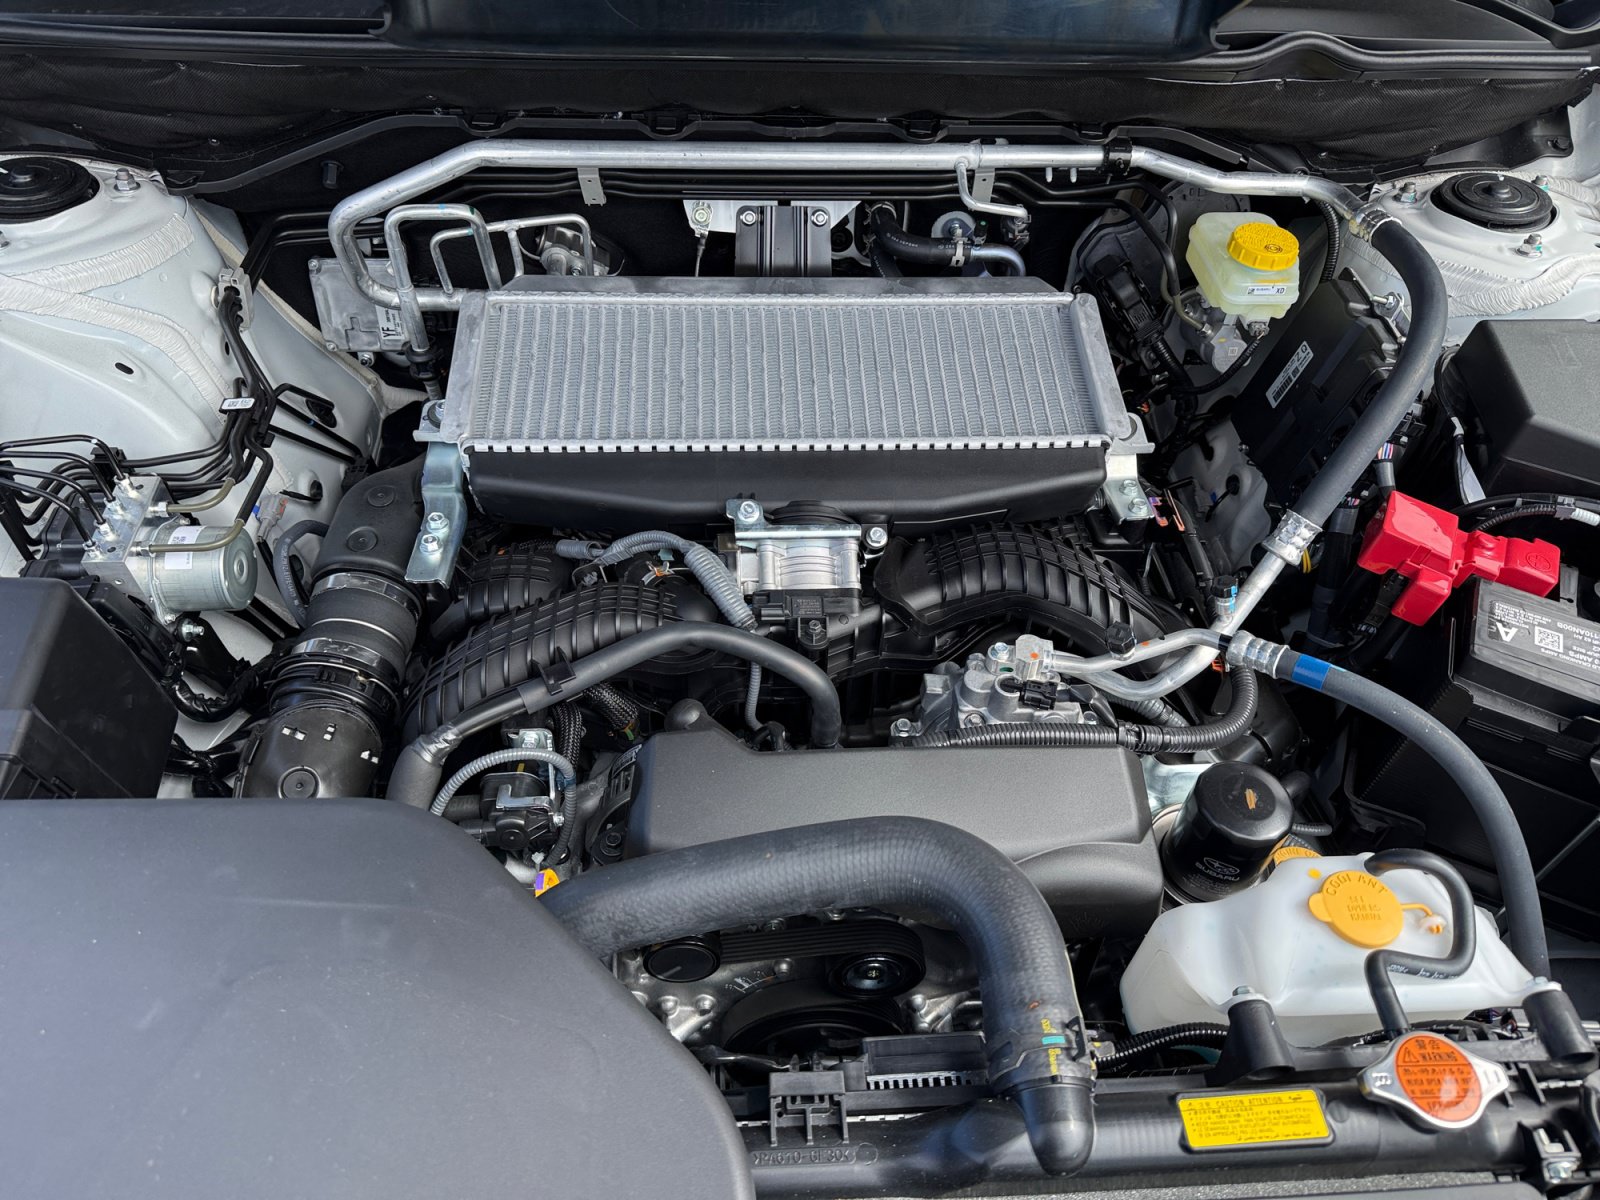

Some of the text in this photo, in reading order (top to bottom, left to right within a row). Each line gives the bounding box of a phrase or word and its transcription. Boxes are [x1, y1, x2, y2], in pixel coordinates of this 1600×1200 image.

[381, 326, 397, 338] YF
[1495, 621, 1519, 642] A
[1195, 861, 1240, 881] SUBARU
[1419, 1051, 1459, 1062] WARNING
[1216, 1099, 1245, 1108] CAUTION
[1248, 1096, 1283, 1105] ATTENTION
